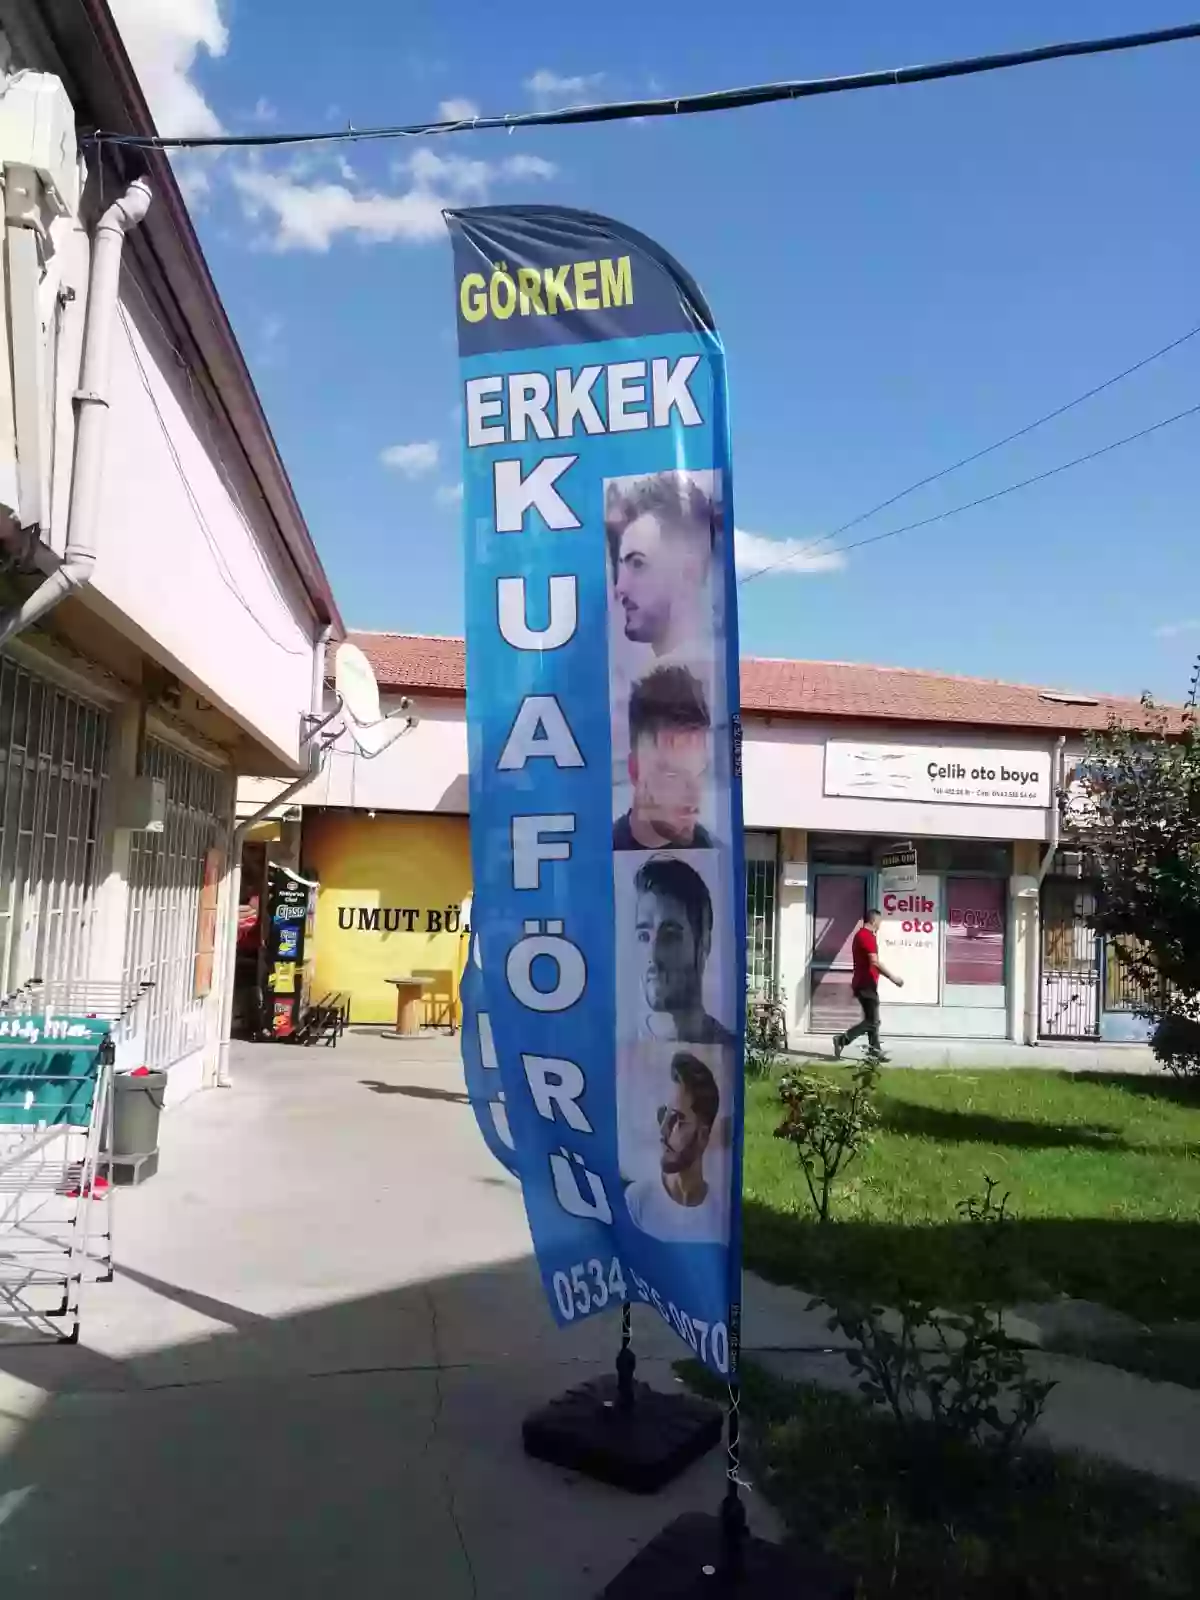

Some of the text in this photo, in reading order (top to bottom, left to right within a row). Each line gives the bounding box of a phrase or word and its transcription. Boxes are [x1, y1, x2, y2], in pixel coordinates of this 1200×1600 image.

[460, 256, 634, 323] GÖRKEM
[464, 355, 704, 447] ERKEK
[927, 762, 1039, 785] Çelik oto boya
[493, 455, 613, 1226] KUAFÖRÜ
[338, 905, 471, 933] UMUT BÜ
[883, 894, 935, 916] Çelik
[901, 918, 934, 934] oto
[553, 1257, 627, 1320] 0534
